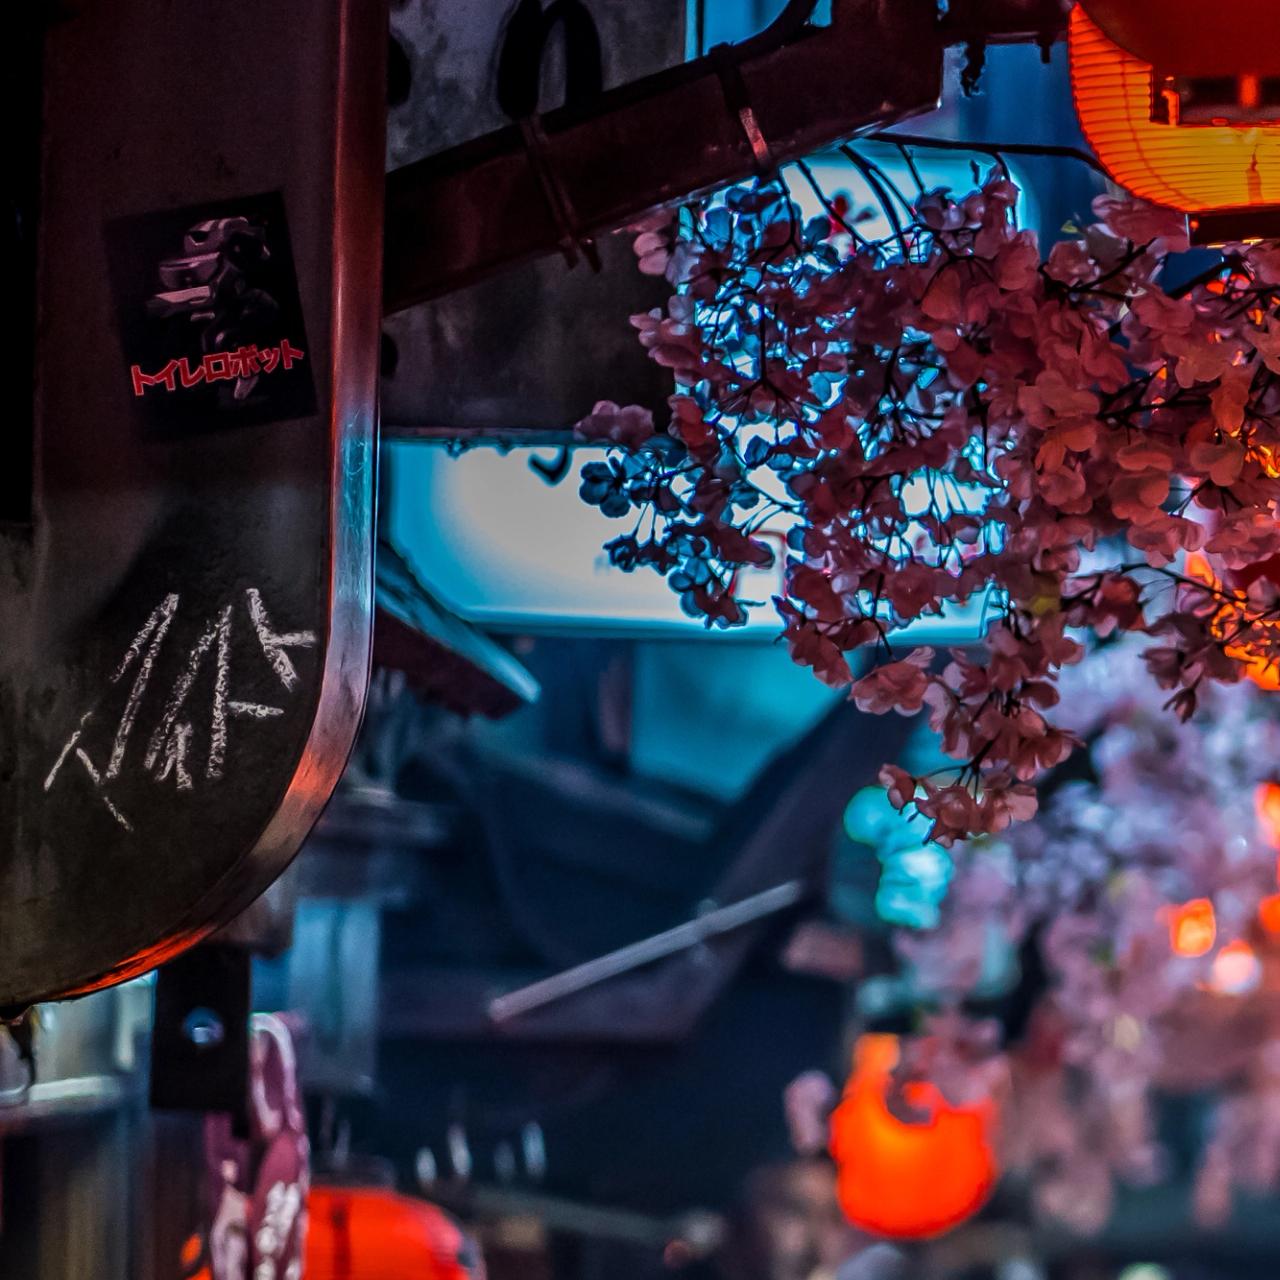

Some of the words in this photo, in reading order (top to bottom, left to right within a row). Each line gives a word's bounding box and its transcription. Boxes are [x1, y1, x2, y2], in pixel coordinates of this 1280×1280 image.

[131, 339, 304, 396] トイレロボット
